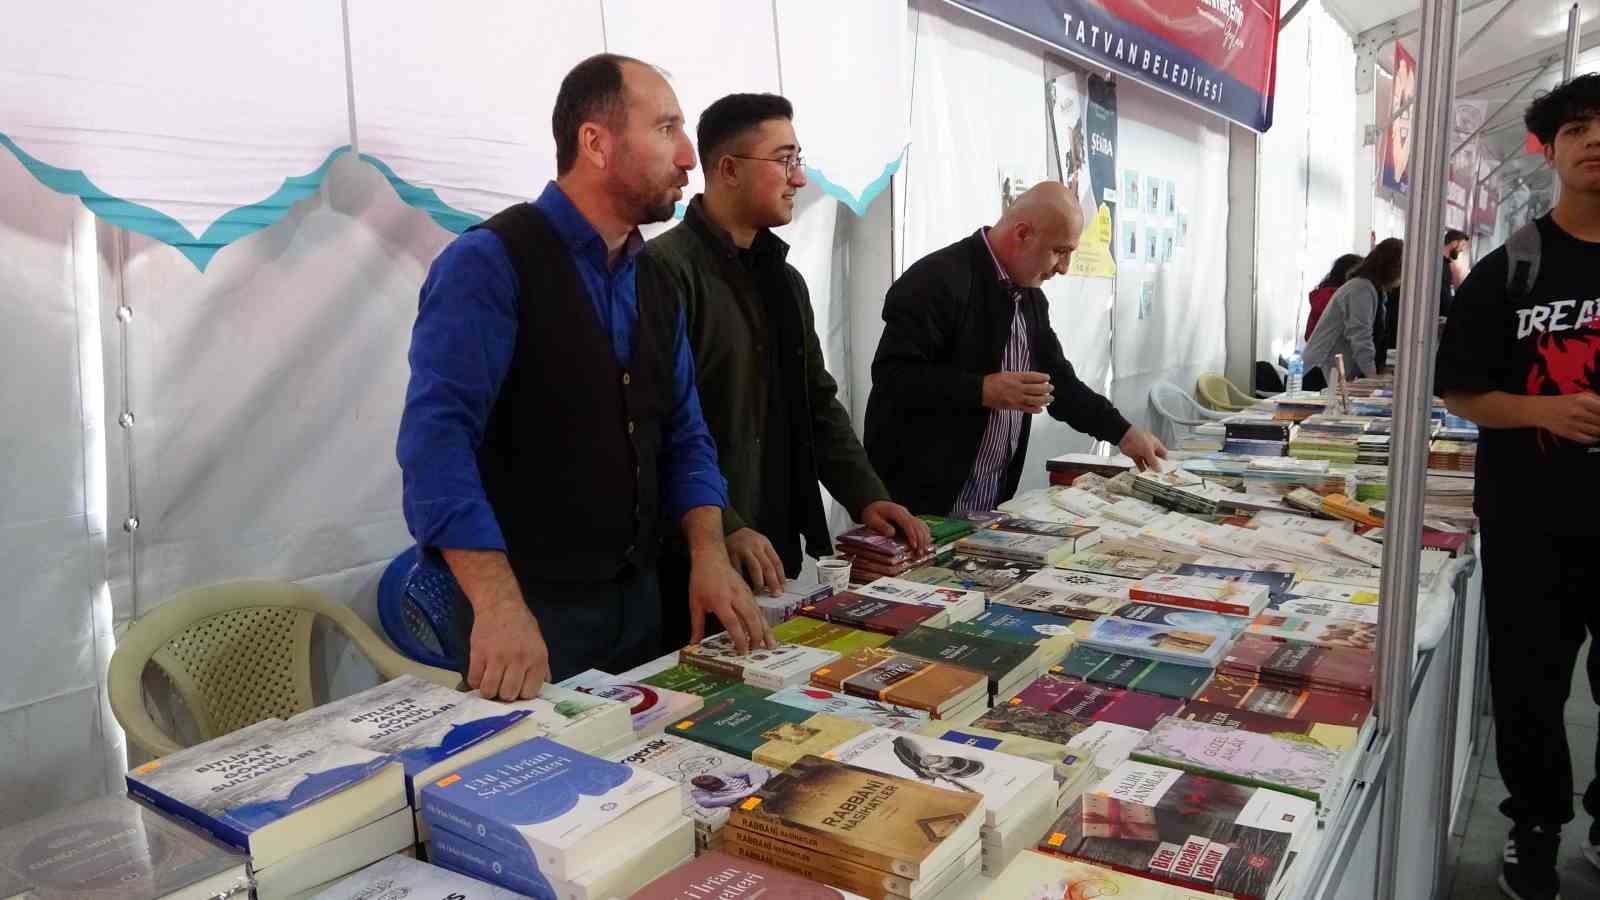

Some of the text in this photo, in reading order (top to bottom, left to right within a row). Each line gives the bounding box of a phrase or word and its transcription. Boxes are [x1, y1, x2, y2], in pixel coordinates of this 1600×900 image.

[1063, 13, 1138, 65] TATVAN
[1142, 51, 1224, 103] BELEDİYESİ
[367, 703, 457, 740] SULTANLARI
[368, 704, 417, 723] YATAN
[210, 749, 318, 793] SULTANLARI
[215, 751, 274, 773] YATAN
[1152, 848, 1177, 870] Bize
[1175, 841, 1205, 874] nezaket
